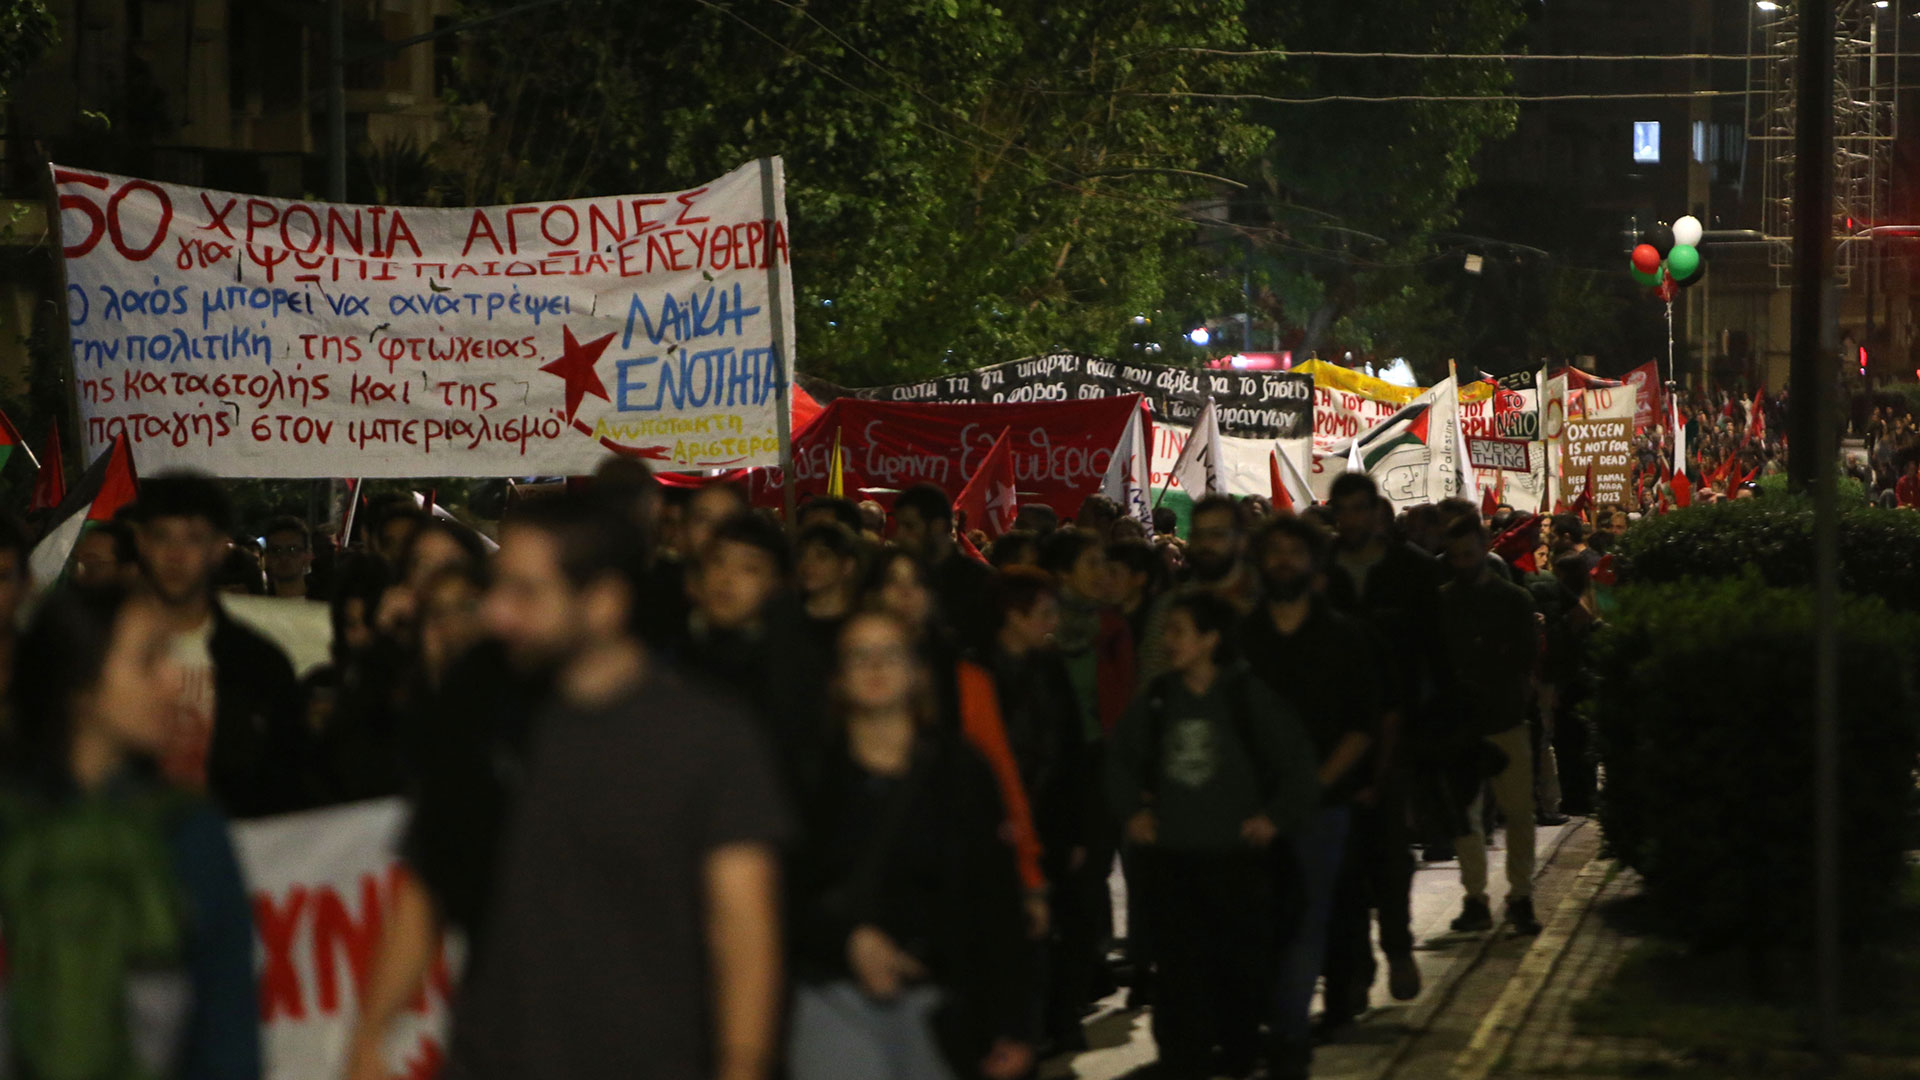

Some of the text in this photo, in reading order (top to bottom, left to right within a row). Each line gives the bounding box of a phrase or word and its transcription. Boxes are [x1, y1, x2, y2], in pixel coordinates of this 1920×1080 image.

[55, 169, 173, 261] 50
[197, 192, 423, 258] ΧΡΟΝΙΑ
[99, 275, 189, 321] λαός
[203, 282, 315, 330] μπορεί
[326, 291, 371, 316] να
[388, 283, 571, 326] ανατρέψει
[126, 319, 272, 366] πολιτική
[299, 333, 363, 364] της
[616, 340, 789, 412] ΕΝΟΤΗΤΑ
[1122, 365, 1153, 385] που
[1209, 375, 1231, 394] να
[77, 376, 115, 404] ης
[437, 380, 499, 411] της
[86, 401, 561, 456] ποταγής στον ιμπεριαλισμό
[1471, 440, 1523, 456] EVERY
[1472, 452, 1525, 468] THING
[1568, 439, 1629, 456] IS NOT FOR
[1570, 455, 1594, 466] THE
[1596, 473, 1626, 482] KAMAL
[1598, 482, 1623, 491] NADA
